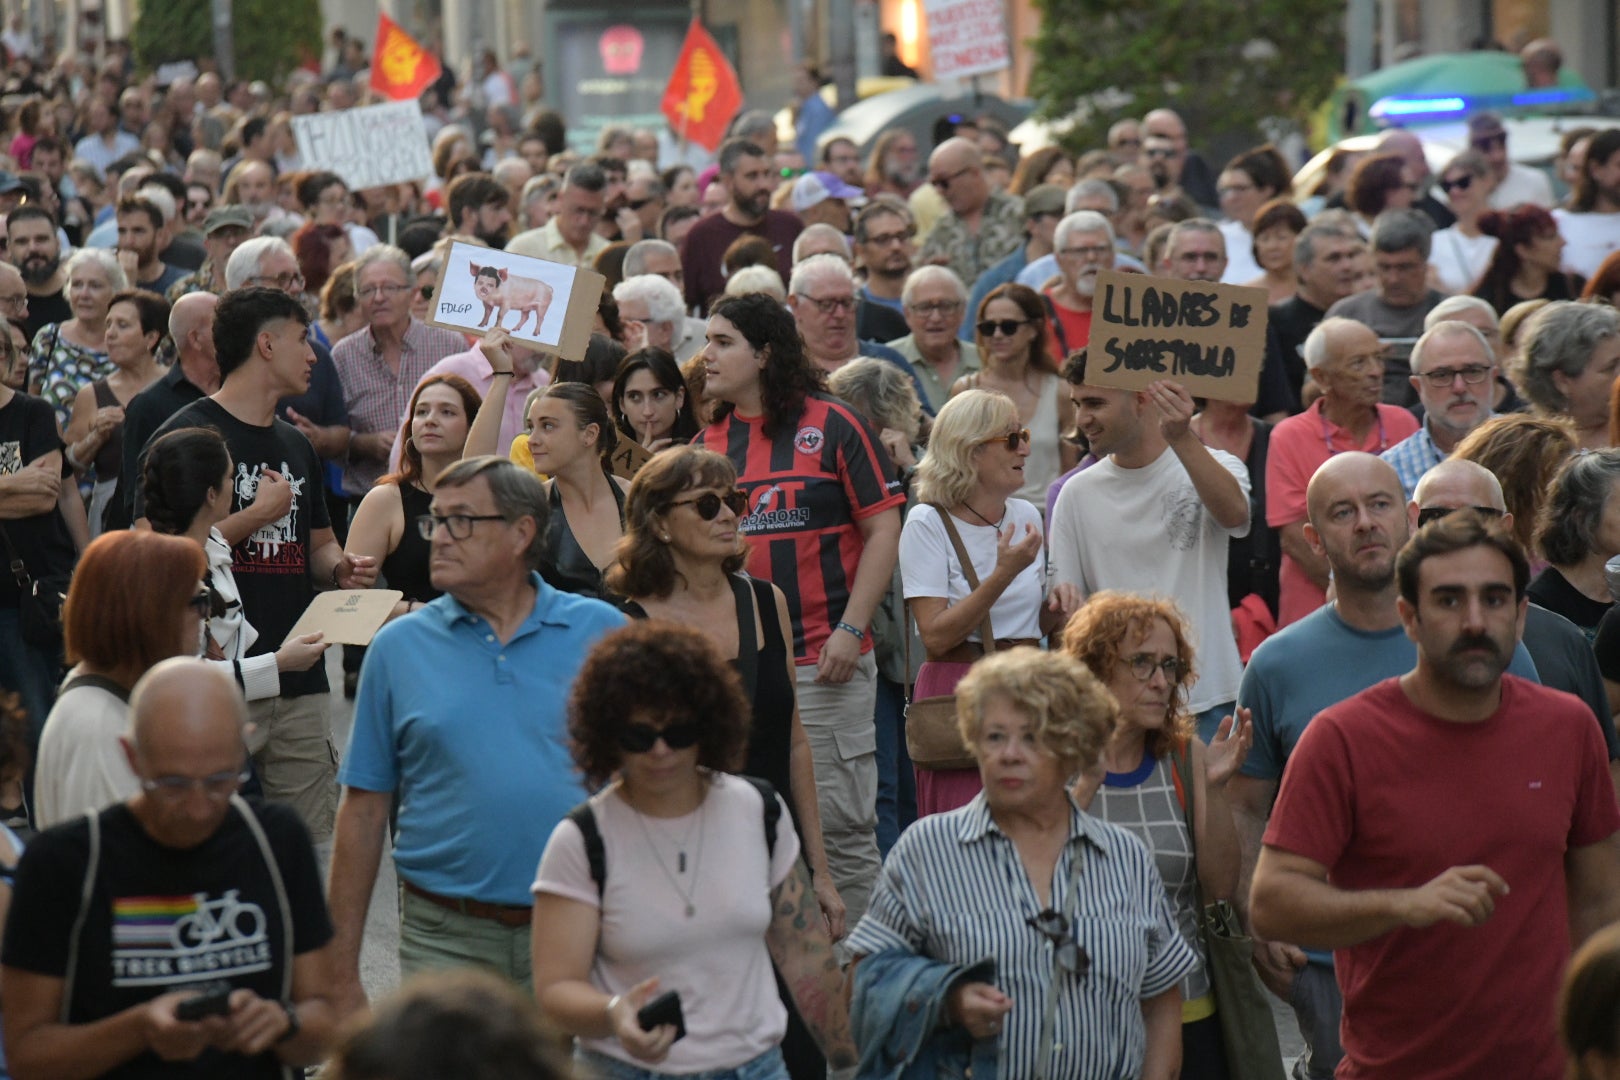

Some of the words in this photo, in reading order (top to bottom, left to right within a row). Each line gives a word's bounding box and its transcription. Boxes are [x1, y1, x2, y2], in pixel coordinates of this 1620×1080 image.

[441, 302, 472, 314] FDLGP
[1103, 284, 1221, 327] LLADRES
[1229, 302, 1252, 328] DE
[766, 520, 805, 529] REVOLUTION
[261, 530, 275, 540] THE
[112, 958, 173, 976] TREK
[177, 942, 270, 974] BICYCLE
